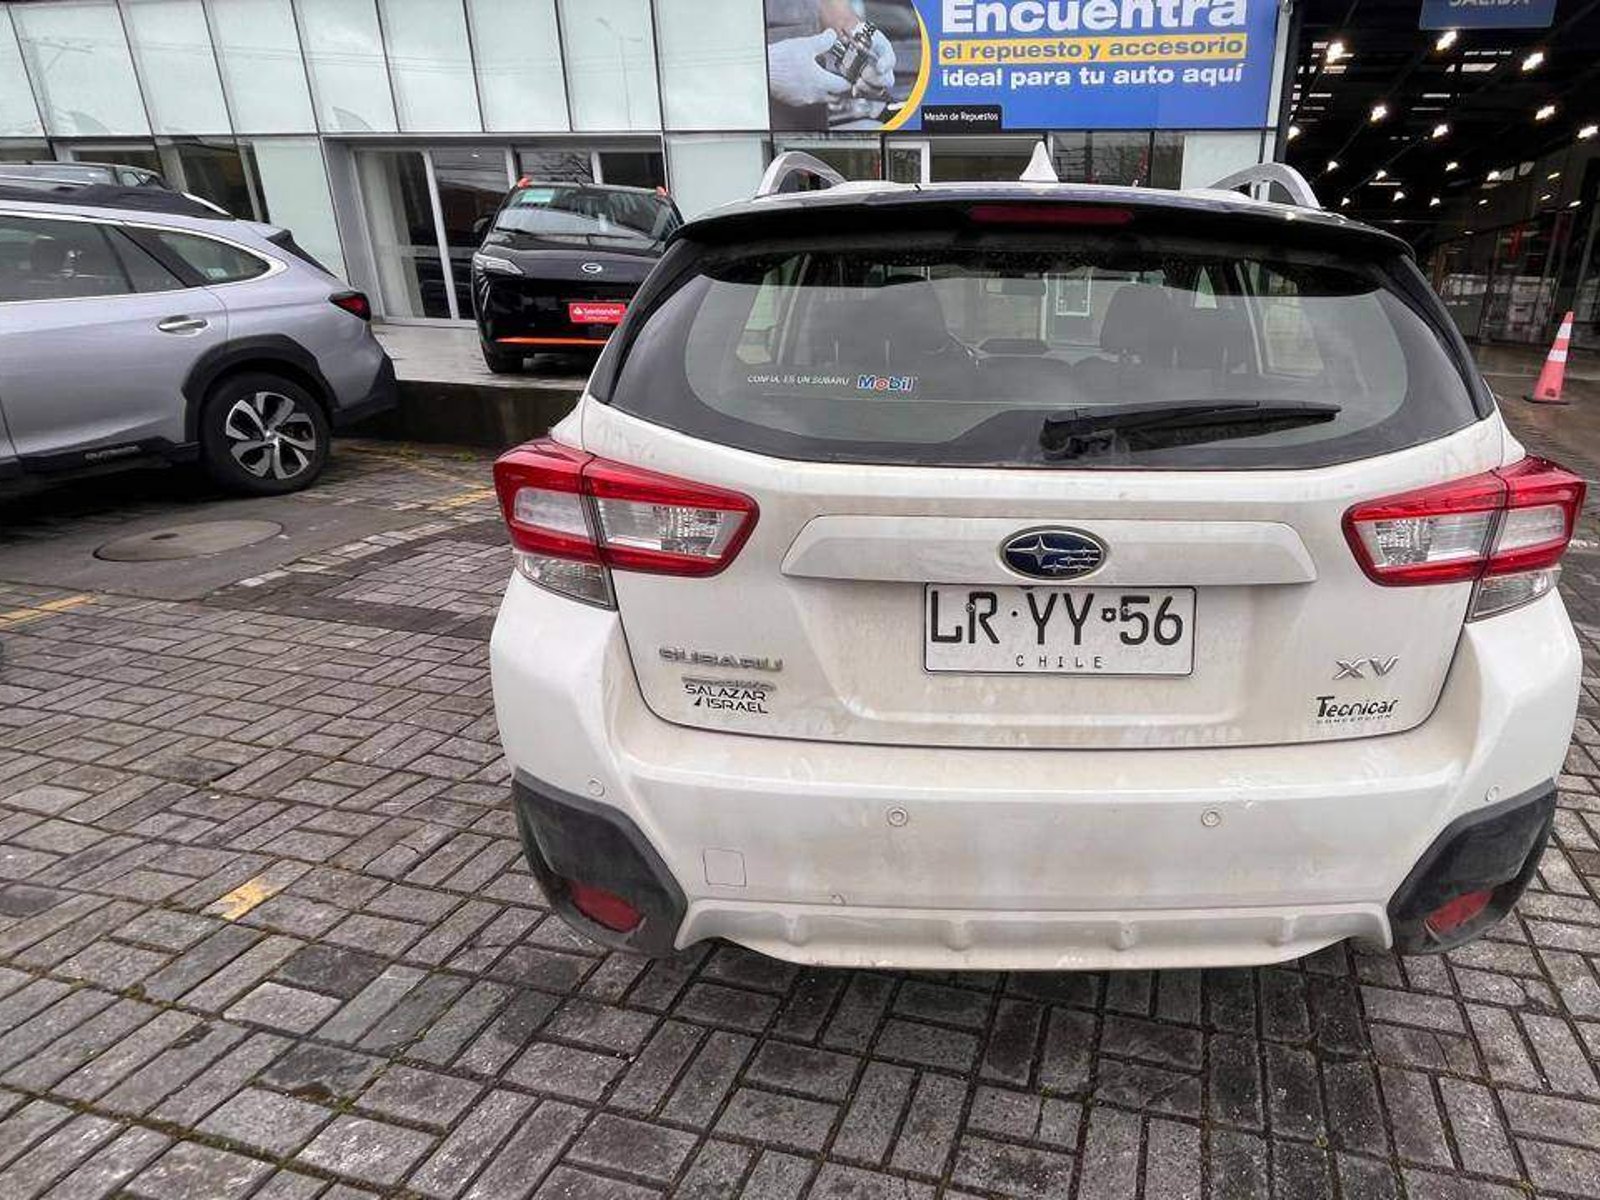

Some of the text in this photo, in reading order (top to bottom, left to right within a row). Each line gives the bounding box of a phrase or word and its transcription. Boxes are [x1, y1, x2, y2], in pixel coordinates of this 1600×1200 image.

[942, 0, 1247, 33] Encuentra
[942, 36, 1243, 62] el repuesto y accesorio
[942, 63, 1244, 90] ideal para tu auto aquí
[949, 112, 959, 121] de
[960, 111, 998, 122] Repuestos
[857, 374, 914, 392] Mobil
[659, 645, 783, 672] SUBARU
[1015, 654, 1104, 669] CHILE
[1332, 654, 1400, 681] XV
[684, 682, 766, 702] SALAZAR
[706, 697, 769, 714] ISRAEL
[1316, 695, 1399, 718] Tecnicar
